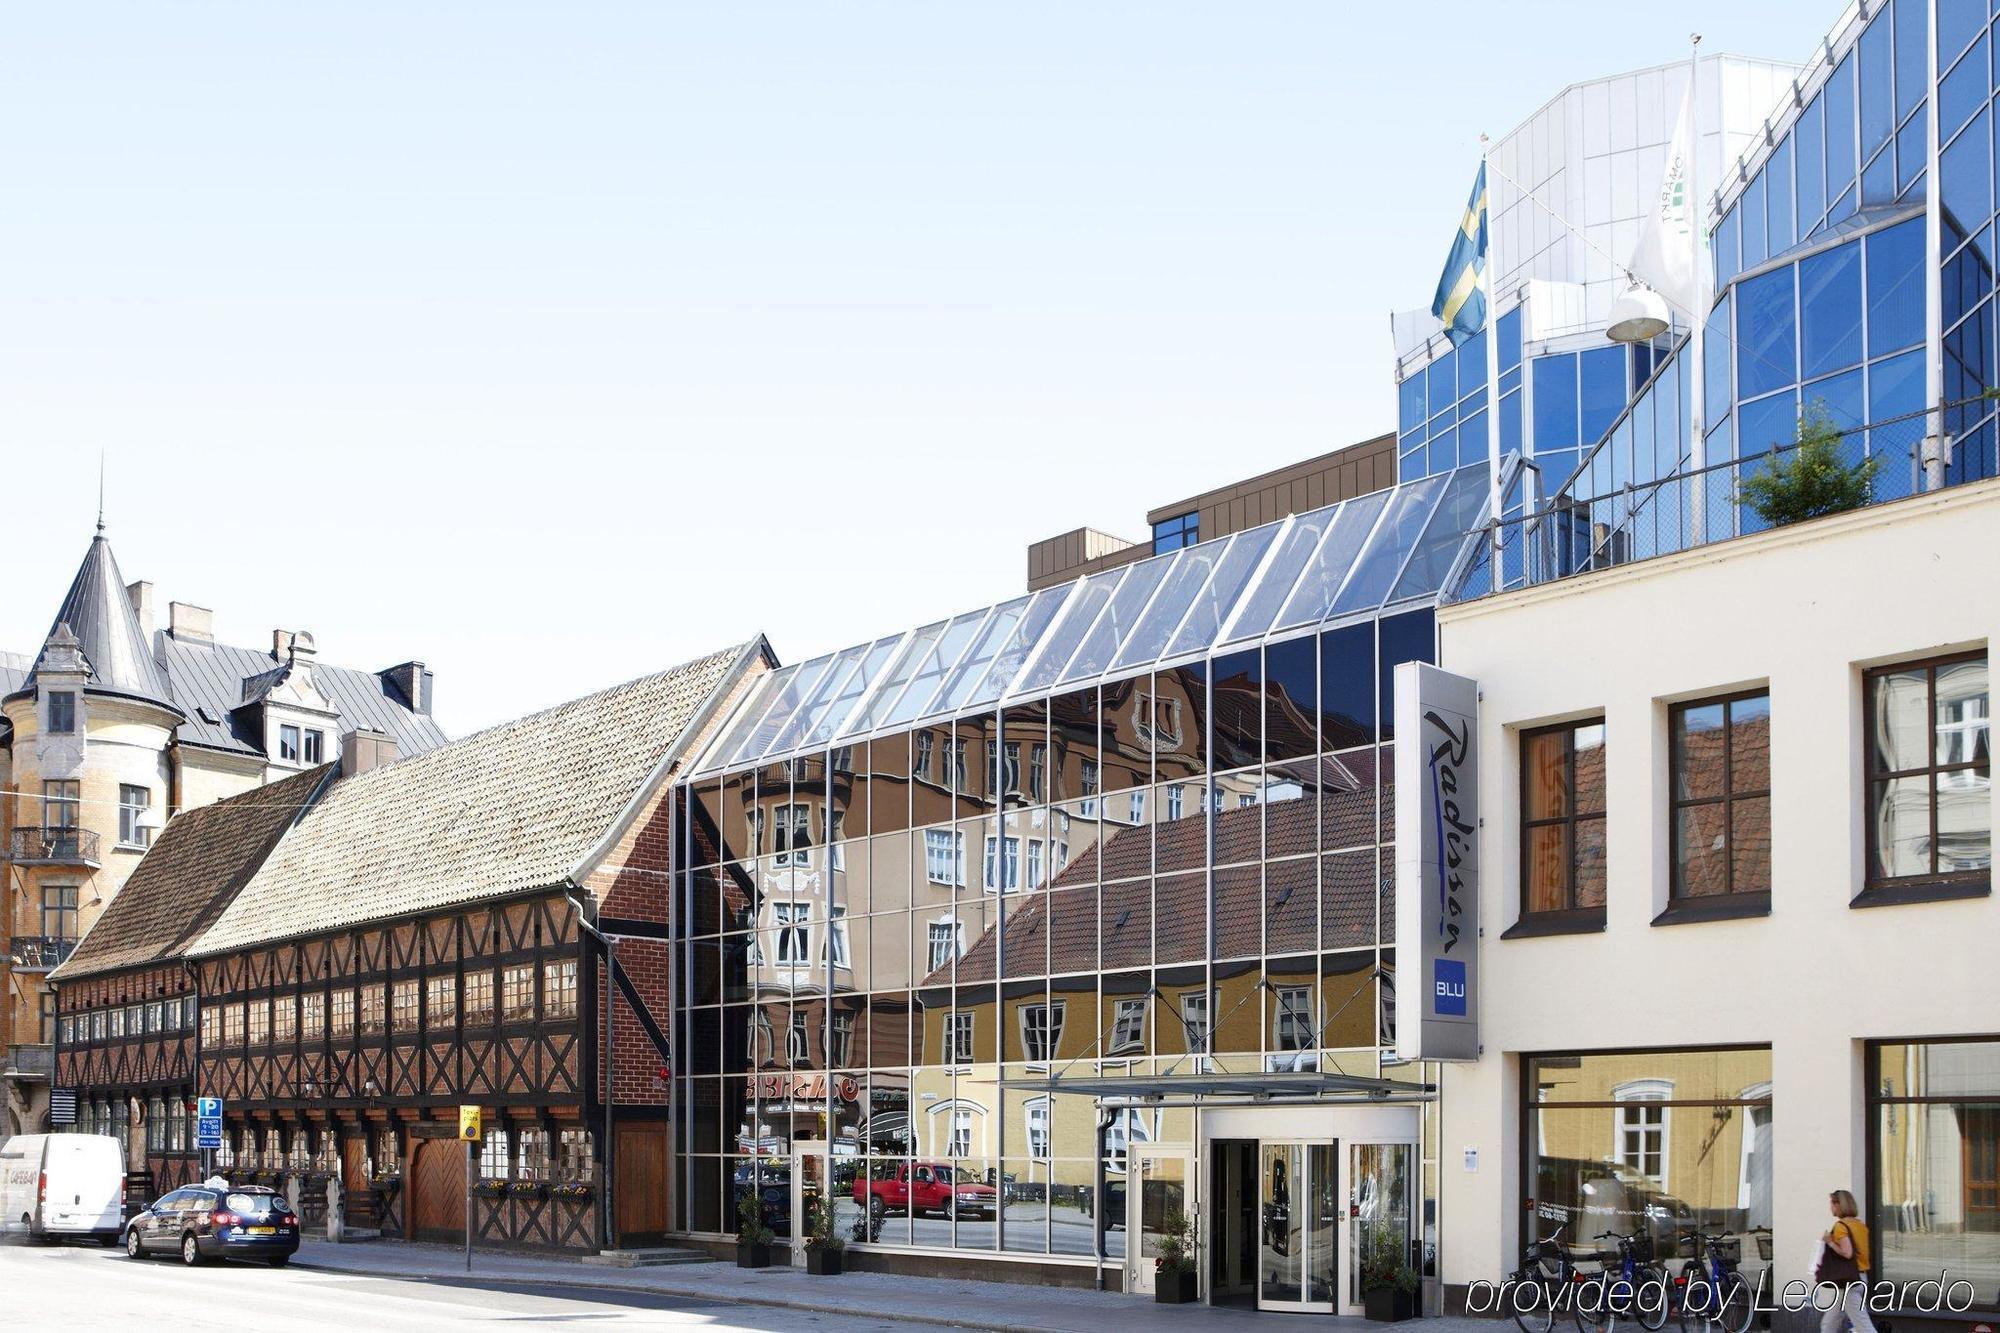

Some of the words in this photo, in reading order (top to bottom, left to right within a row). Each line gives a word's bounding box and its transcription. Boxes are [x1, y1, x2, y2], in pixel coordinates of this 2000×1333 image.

[1424, 711, 1474, 954] Radisson
[1436, 981, 1464, 997] BLU
[205, 1101, 217, 1116] P
